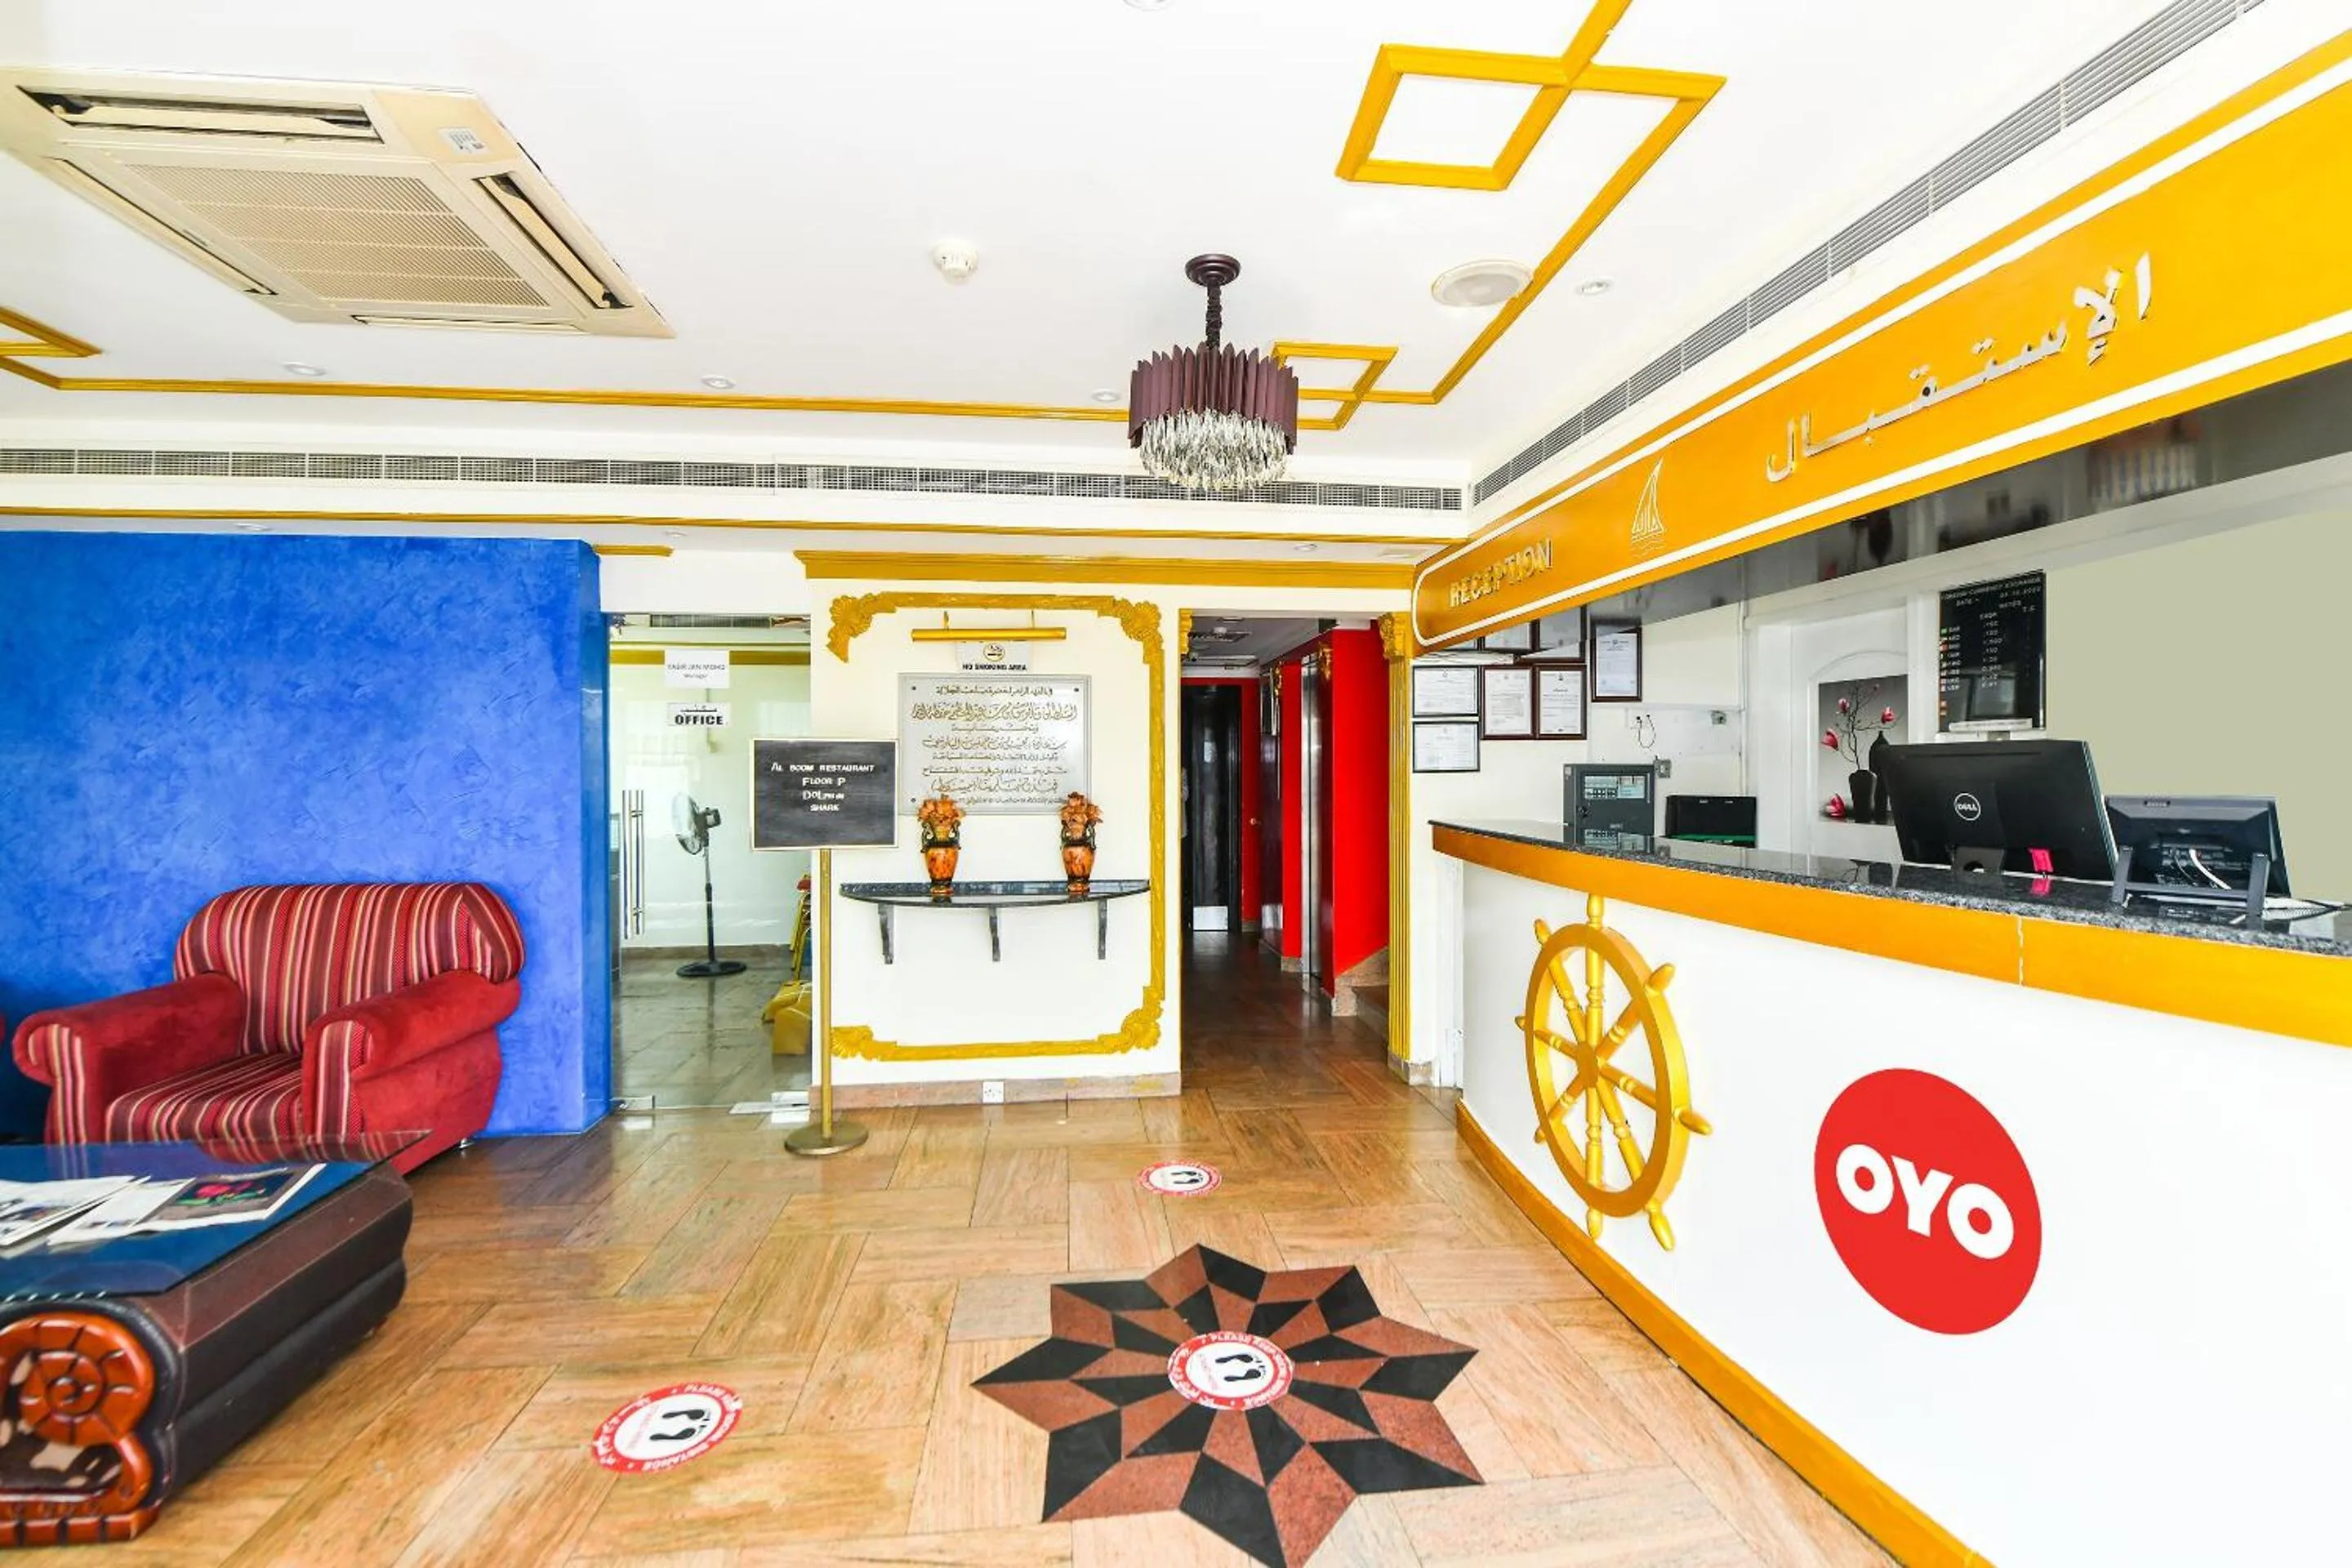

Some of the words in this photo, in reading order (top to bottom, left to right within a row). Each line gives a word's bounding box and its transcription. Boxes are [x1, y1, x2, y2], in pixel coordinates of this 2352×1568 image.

[1450, 538, 1552, 607] RECEPTION
[675, 715, 724, 725] OFFICE
[790, 764, 814, 773] BOOM
[819, 764, 875, 773] RESTAURANT
[838, 777, 846, 786] P
[810, 804, 840, 812] SHARK
[1958, 803, 1977, 811] DELL
[1836, 1143, 2015, 1259] OYO
[1211, 1333, 1253, 1343] PLEASE
